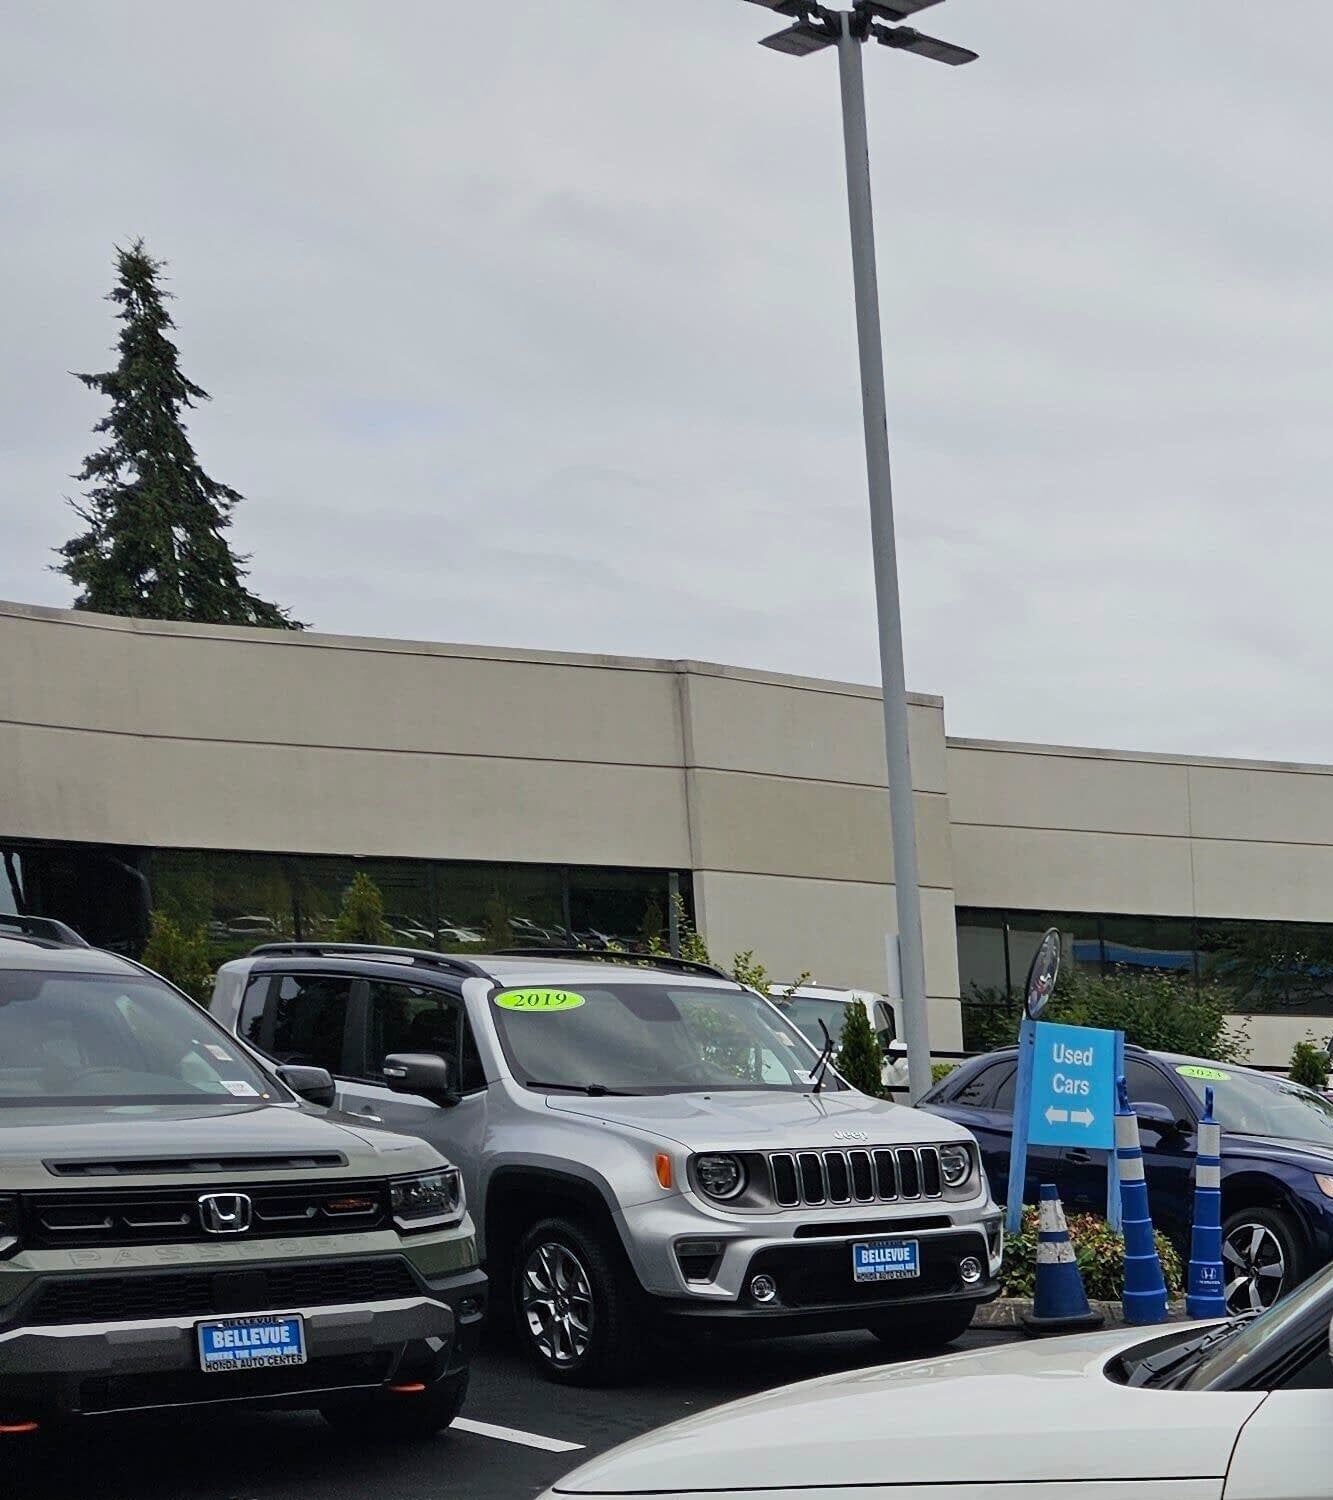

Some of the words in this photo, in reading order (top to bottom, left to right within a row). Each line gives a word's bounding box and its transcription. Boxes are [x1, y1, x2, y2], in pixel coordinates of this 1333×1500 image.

[513, 993, 567, 1007] 2019
[1053, 1043, 1094, 1067] Used
[1053, 1073, 1090, 1095] Cars
[832, 1129, 869, 1142] Jeep
[862, 1247, 910, 1263] BELLEVUE
[212, 1325, 291, 1349] BELLEVUE
[205, 1359, 238, 1372] HONDA
[240, 1357, 265, 1369] AUTO
[267, 1353, 303, 1366] CENTER
